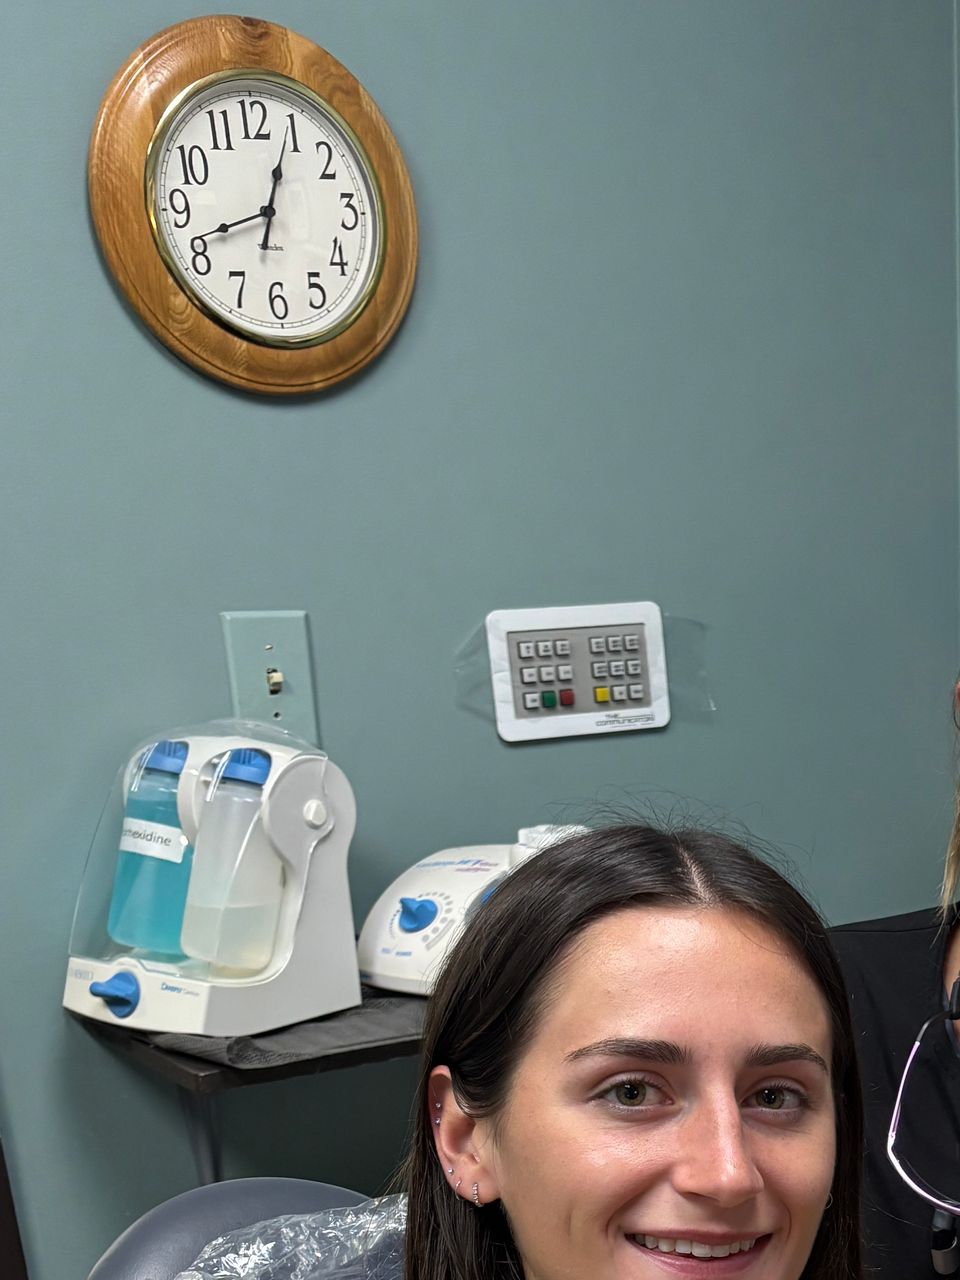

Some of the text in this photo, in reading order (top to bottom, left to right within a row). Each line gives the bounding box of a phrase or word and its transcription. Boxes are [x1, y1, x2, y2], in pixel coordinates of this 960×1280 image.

[205, 109, 235, 151] 11
[237, 98, 271, 141] 12
[286, 113, 300, 153] 1
[176, 144, 209, 185] 10
[316, 141, 336, 180] 2
[169, 188, 191, 229] 9
[339, 192, 359, 230] 3
[190, 236, 211, 276] 8
[329, 236, 348, 276] 4
[228, 270, 246, 308] 7
[268, 281, 288, 320] 6
[307, 271, 326, 309] 5
